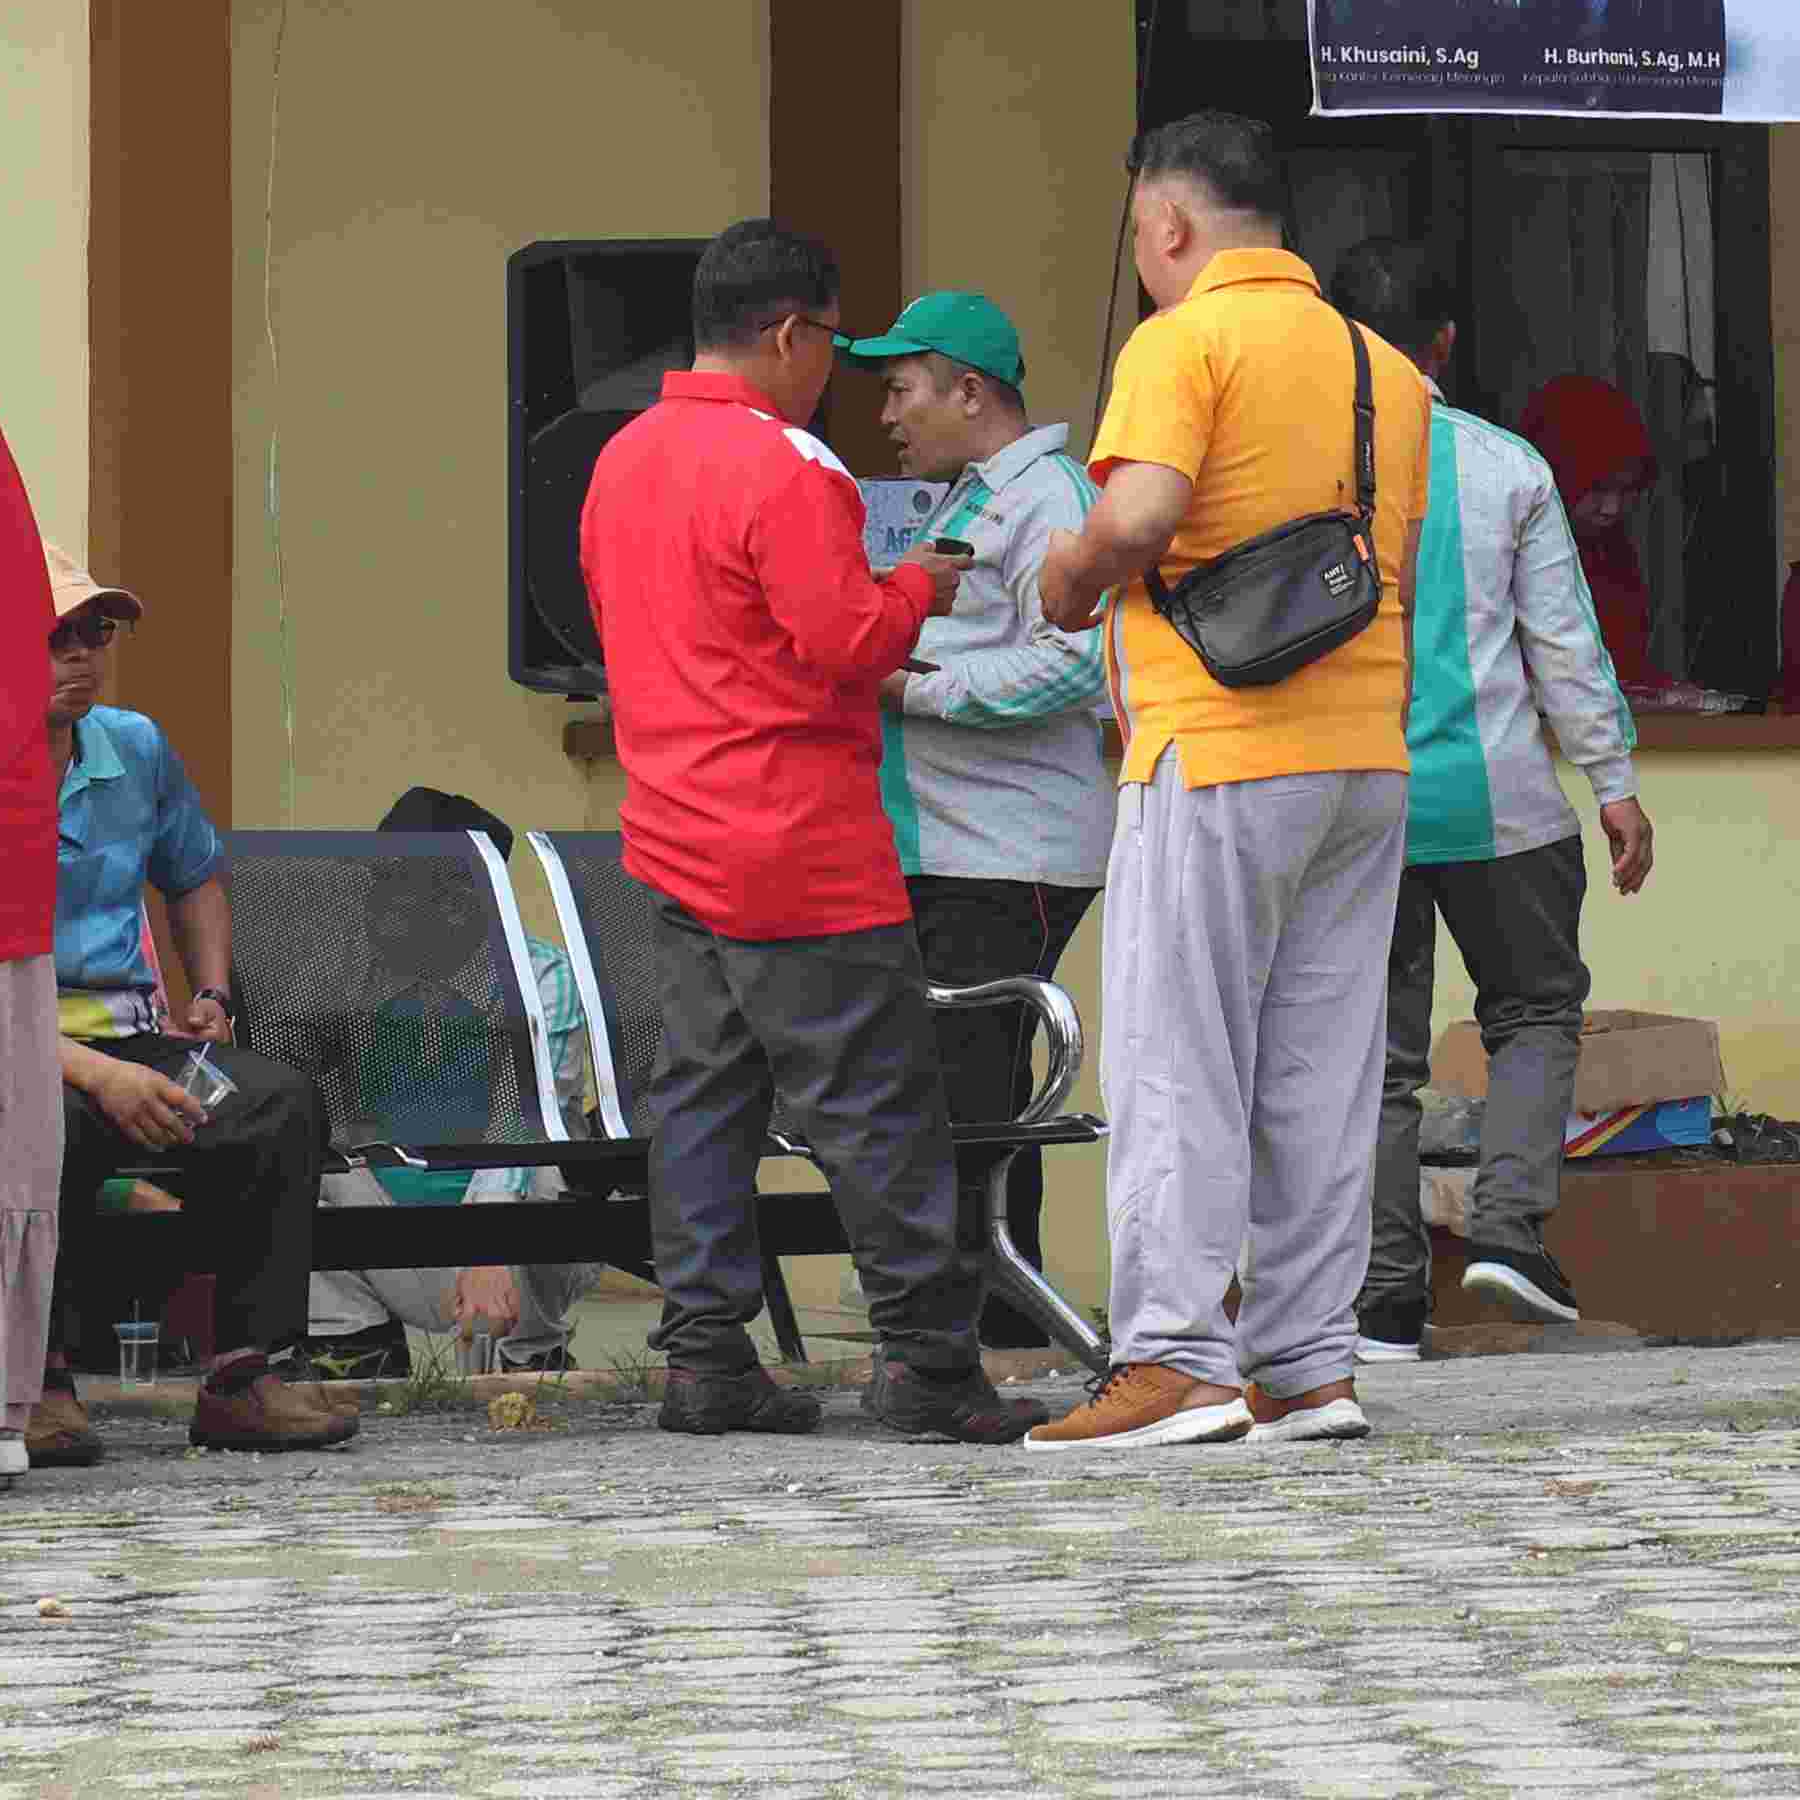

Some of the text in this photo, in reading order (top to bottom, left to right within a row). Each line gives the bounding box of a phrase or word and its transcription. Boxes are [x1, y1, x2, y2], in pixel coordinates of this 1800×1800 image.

[1320, 45, 1480, 69] H. Khusaini, S.Ag
[1543, 47, 1721, 72] H. Burhani, S.Ag, M.H
